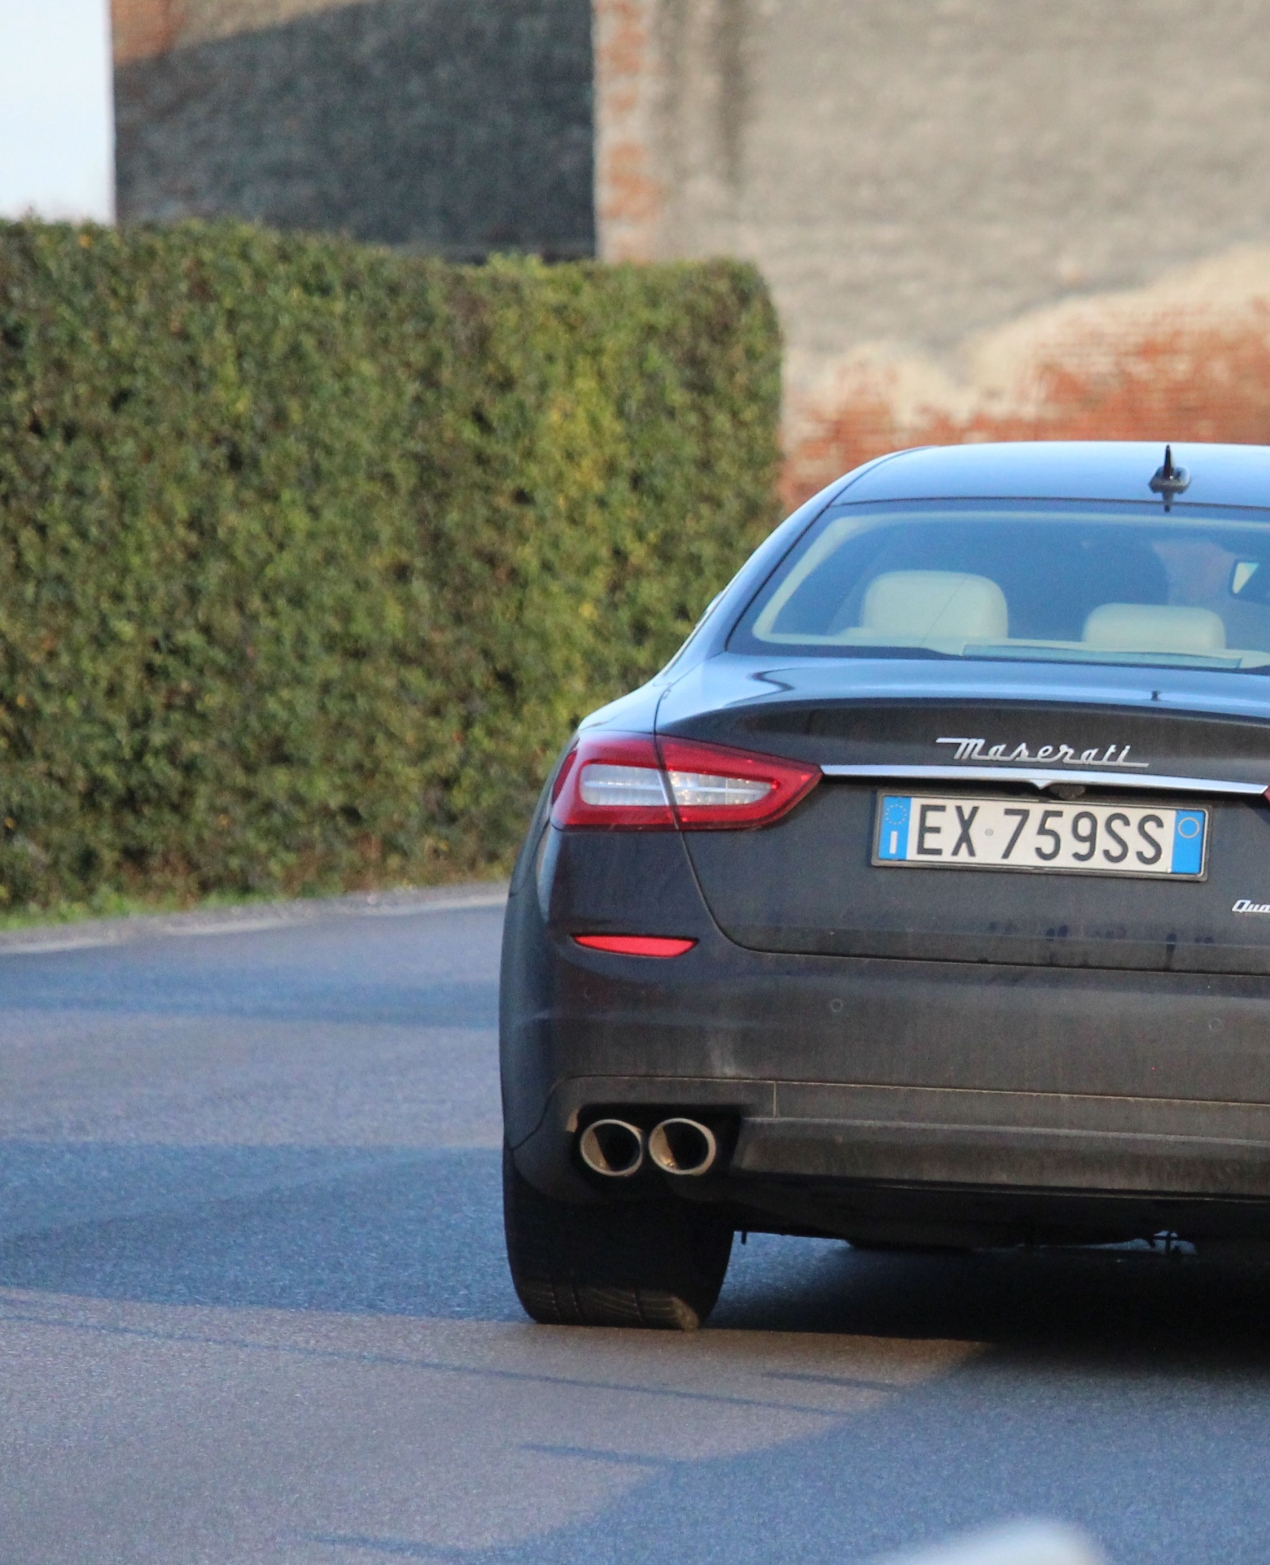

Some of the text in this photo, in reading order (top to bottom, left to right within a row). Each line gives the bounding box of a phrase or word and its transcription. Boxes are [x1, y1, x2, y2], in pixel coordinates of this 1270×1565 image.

[935, 737, 1150, 768] Maserati
[916, 804, 1164, 865] EX 759SS
